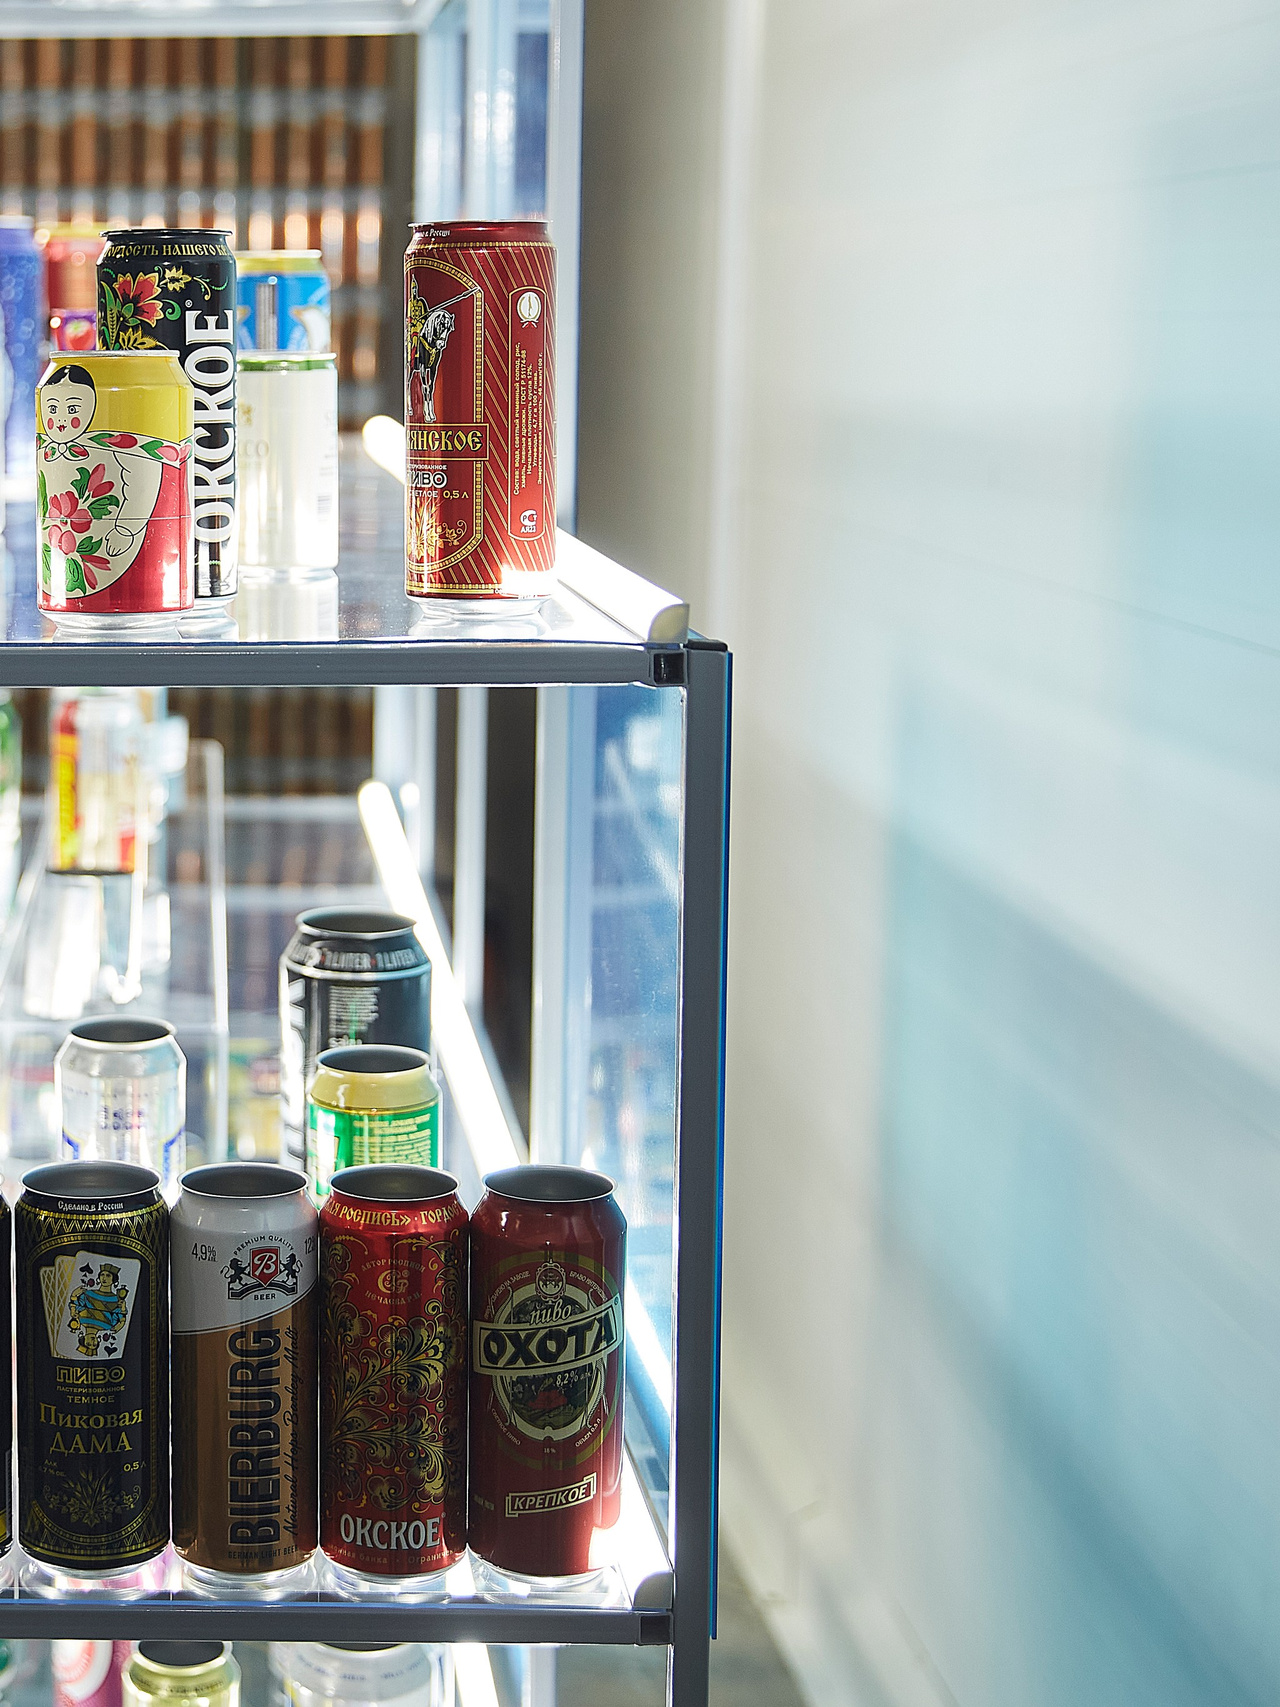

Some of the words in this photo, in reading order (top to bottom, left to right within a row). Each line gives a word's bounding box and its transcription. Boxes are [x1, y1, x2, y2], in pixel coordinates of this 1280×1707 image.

[162, 244, 216, 256] НАШЕГО
[184, 310, 236, 543] ОКСКОЕ
[406, 430, 483, 451] ВЯНСКОЕ
[443, 490, 459, 499] 0,5
[57, 1200, 89, 1211] Сделано
[97, 1201, 124, 1211] России
[340, 1205, 411, 1226] РОСПИСЬ»
[420, 1200, 465, 1225] ГОРДОСТ
[233, 1235, 265, 1256] PREMIUM
[268, 1235, 294, 1251] QUALITY
[361, 1259, 386, 1272] АВТОР
[253, 1293, 276, 1301] BEER
[529, 1300, 572, 1326] пиво
[283, 1325, 299, 1369] Malt
[483, 1309, 615, 1366] ОХОТА
[56, 1366, 126, 1384] ПИВО
[556, 1370, 579, 1388] 8,2%
[56, 1385, 125, 1393] ПАСТЕРИЗОВАННОЕ
[67, 1395, 115, 1404] ТЕМНОЕ
[283, 1369, 304, 1427] Barley
[39, 1402, 144, 1429] Пиковая
[49, 1431, 133, 1457] ДАМА
[227, 1328, 282, 1546] BIERBURG
[283, 1431, 299, 1468] Hops
[123, 1461, 140, 1472] 0,5
[283, 1473, 299, 1535] Natural
[514, 1484, 588, 1510] КРЕПКОЕ
[340, 1513, 441, 1550] ОКСКОЕ
[228, 1550, 259, 1559] GERMAN
[261, 1550, 281, 1559] LIGHT
[283, 1544, 299, 1556] BEER
